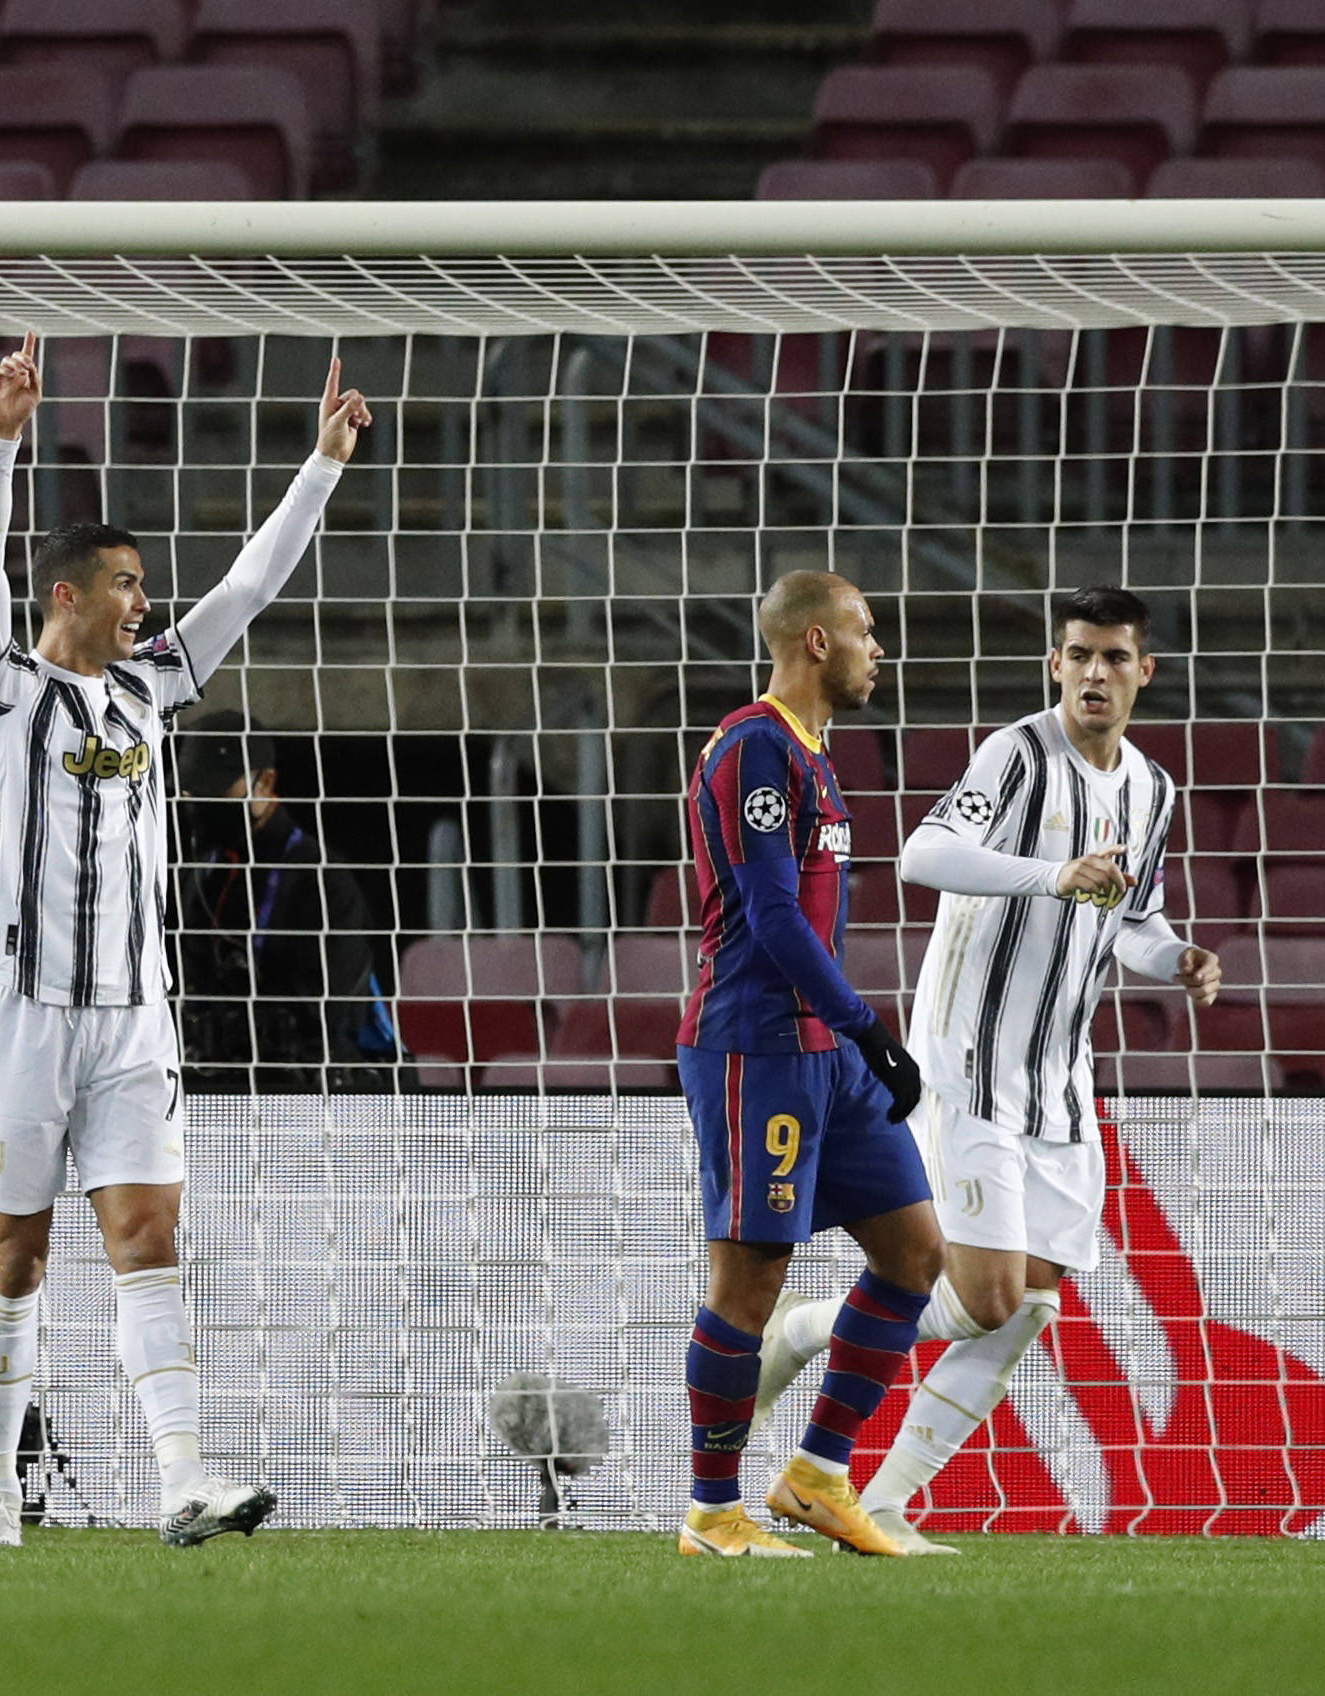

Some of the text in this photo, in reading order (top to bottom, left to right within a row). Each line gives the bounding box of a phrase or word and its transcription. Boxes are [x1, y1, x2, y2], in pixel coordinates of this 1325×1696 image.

[63, 735, 149, 782] Jeep
[166, 1068, 178, 1122] 7
[766, 1114, 800, 1176] 9
